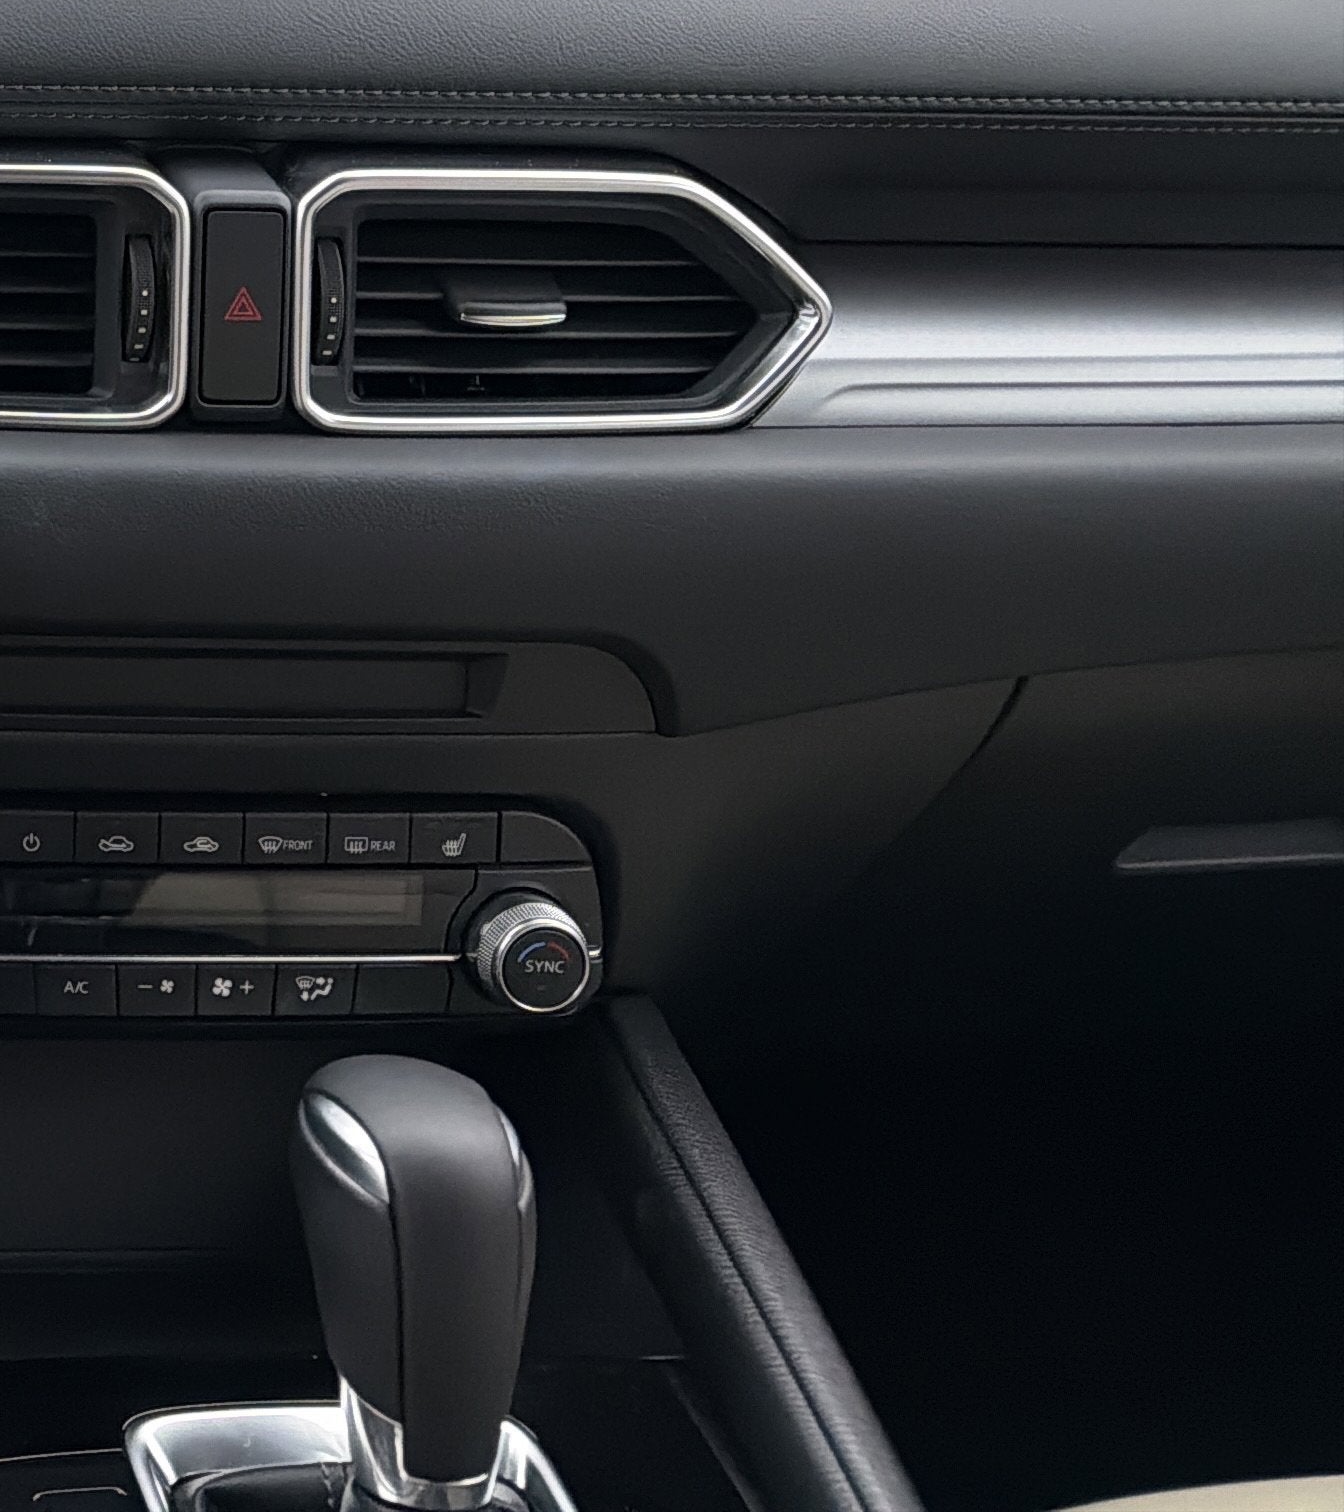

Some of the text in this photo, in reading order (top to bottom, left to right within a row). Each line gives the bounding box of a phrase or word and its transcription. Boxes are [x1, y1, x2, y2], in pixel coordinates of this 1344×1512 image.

[282, 839, 313, 851] FRONT
[370, 839, 396, 851] REAR
[524, 959, 565, 974] SYNC
[63, 980, 89, 995] A/C
